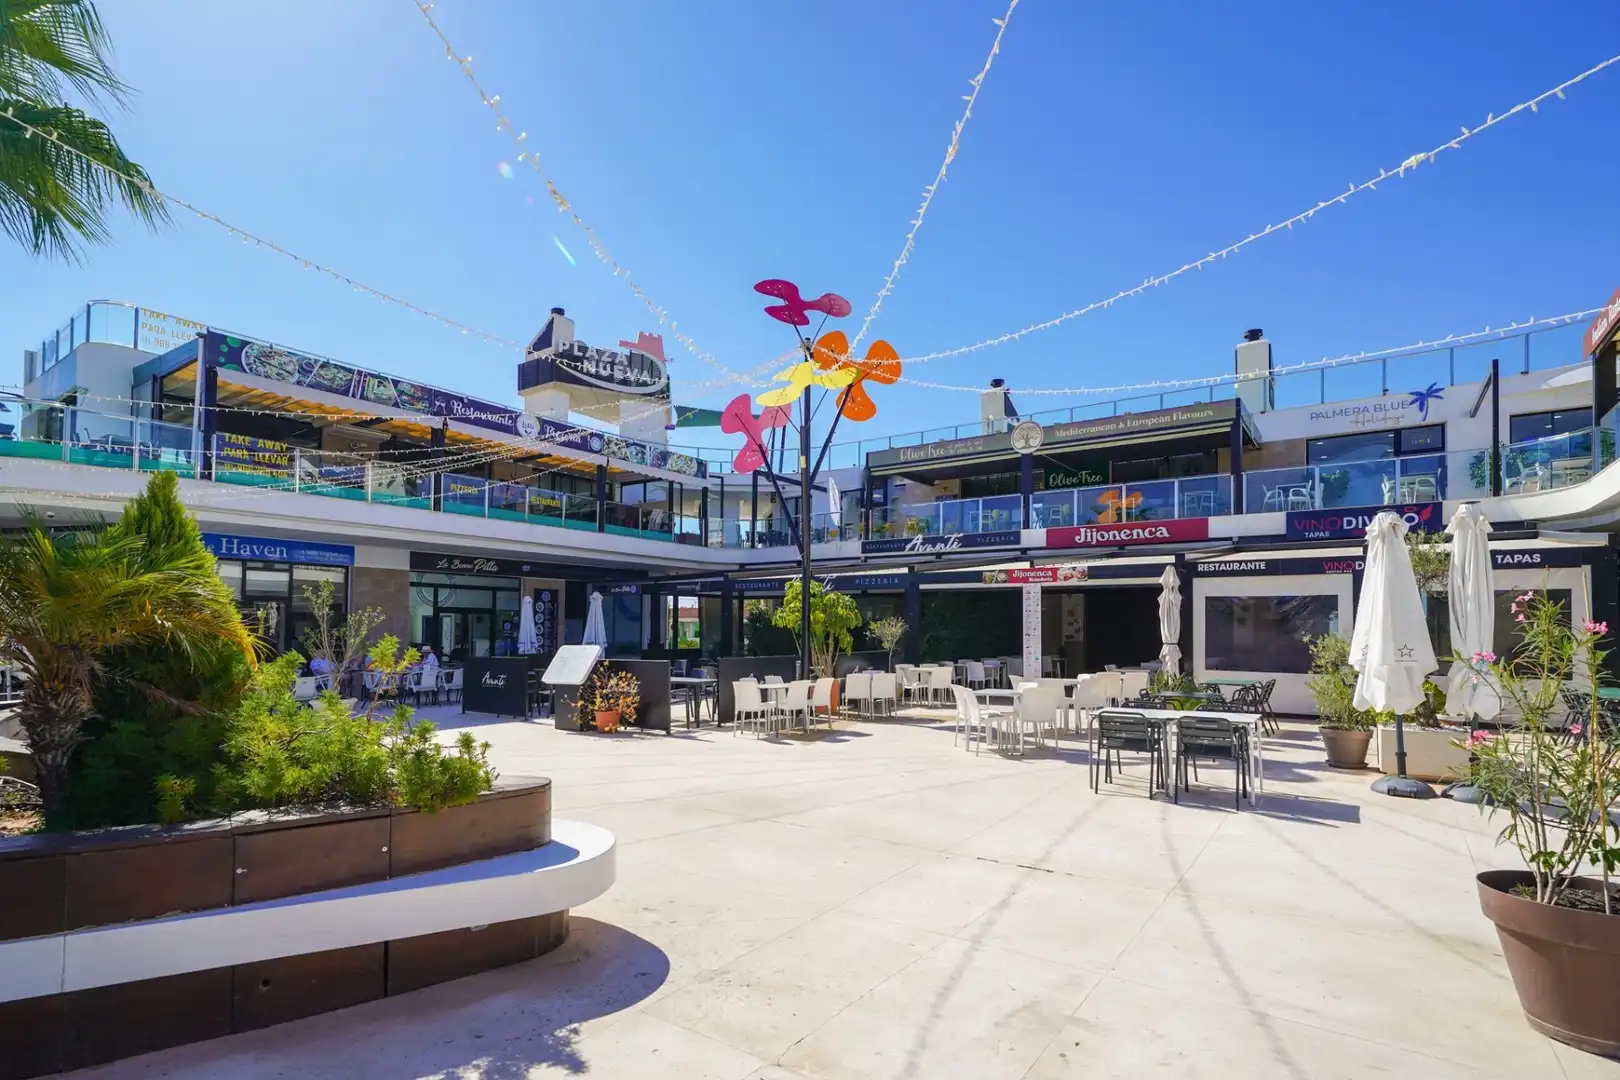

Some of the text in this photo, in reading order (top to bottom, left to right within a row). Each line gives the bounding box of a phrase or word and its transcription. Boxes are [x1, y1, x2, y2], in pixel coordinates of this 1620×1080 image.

[141, 321, 166, 335] PARA
[559, 340, 629, 366] PLAZA
[582, 359, 652, 384] NUEVA
[1310, 400, 1410, 421] PALMERA BLUE
[1055, 409, 1214, 438] Mediterranean & European Flavours
[224, 433, 288, 452] TAKE AWAY
[223, 447, 288, 466] PARA LLEVAR
[1049, 470, 1103, 487] Olive Tree
[450, 483, 479, 495] PIZZERIA
[904, 532, 964, 552] Avanti
[975, 535, 1015, 544] PIZZERIA
[1074, 526, 1170, 545] Jijonenca
[220, 537, 288, 558] Haven
[1197, 561, 1267, 572] RESTAURANTE
[1495, 553, 1542, 564] TAPAS
[735, 577, 900, 589] RESTAURANTE PIZZERIA
[1012, 569, 1053, 579] Jijonenca
[481, 670, 507, 686] Avanti
